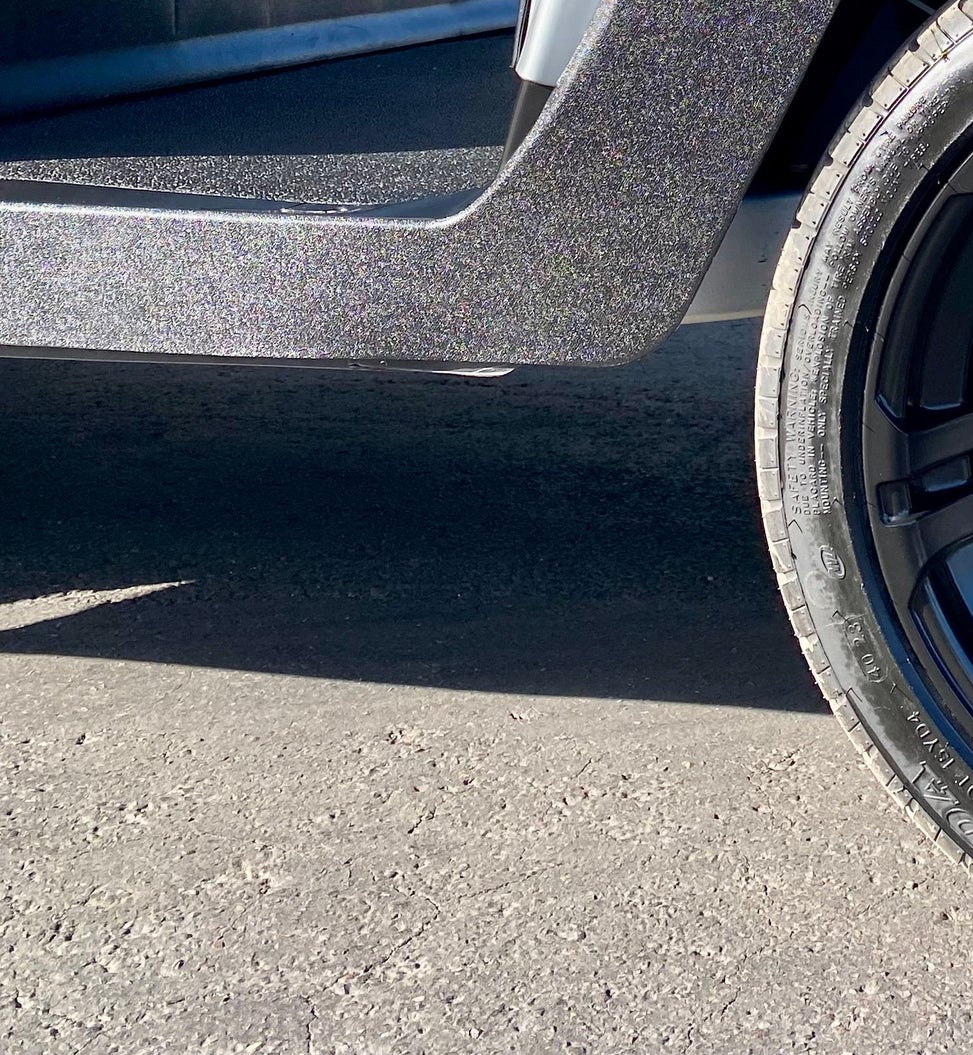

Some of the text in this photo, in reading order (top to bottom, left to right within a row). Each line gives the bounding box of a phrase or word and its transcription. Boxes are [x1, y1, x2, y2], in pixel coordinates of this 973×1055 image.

[826, 294, 847, 339] TRAINED
[818, 344, 835, 403] SPECIALLY
[786, 367, 800, 442] WARNING:
[816, 409, 827, 438] ONLY
[806, 444, 816, 458] IN
[787, 452, 801, 515] SAFETY
[798, 471, 808, 487] TO
[807, 463, 822, 515] PLACARD
[800, 494, 812, 516] DUE
[861, 652, 882, 682] 40
